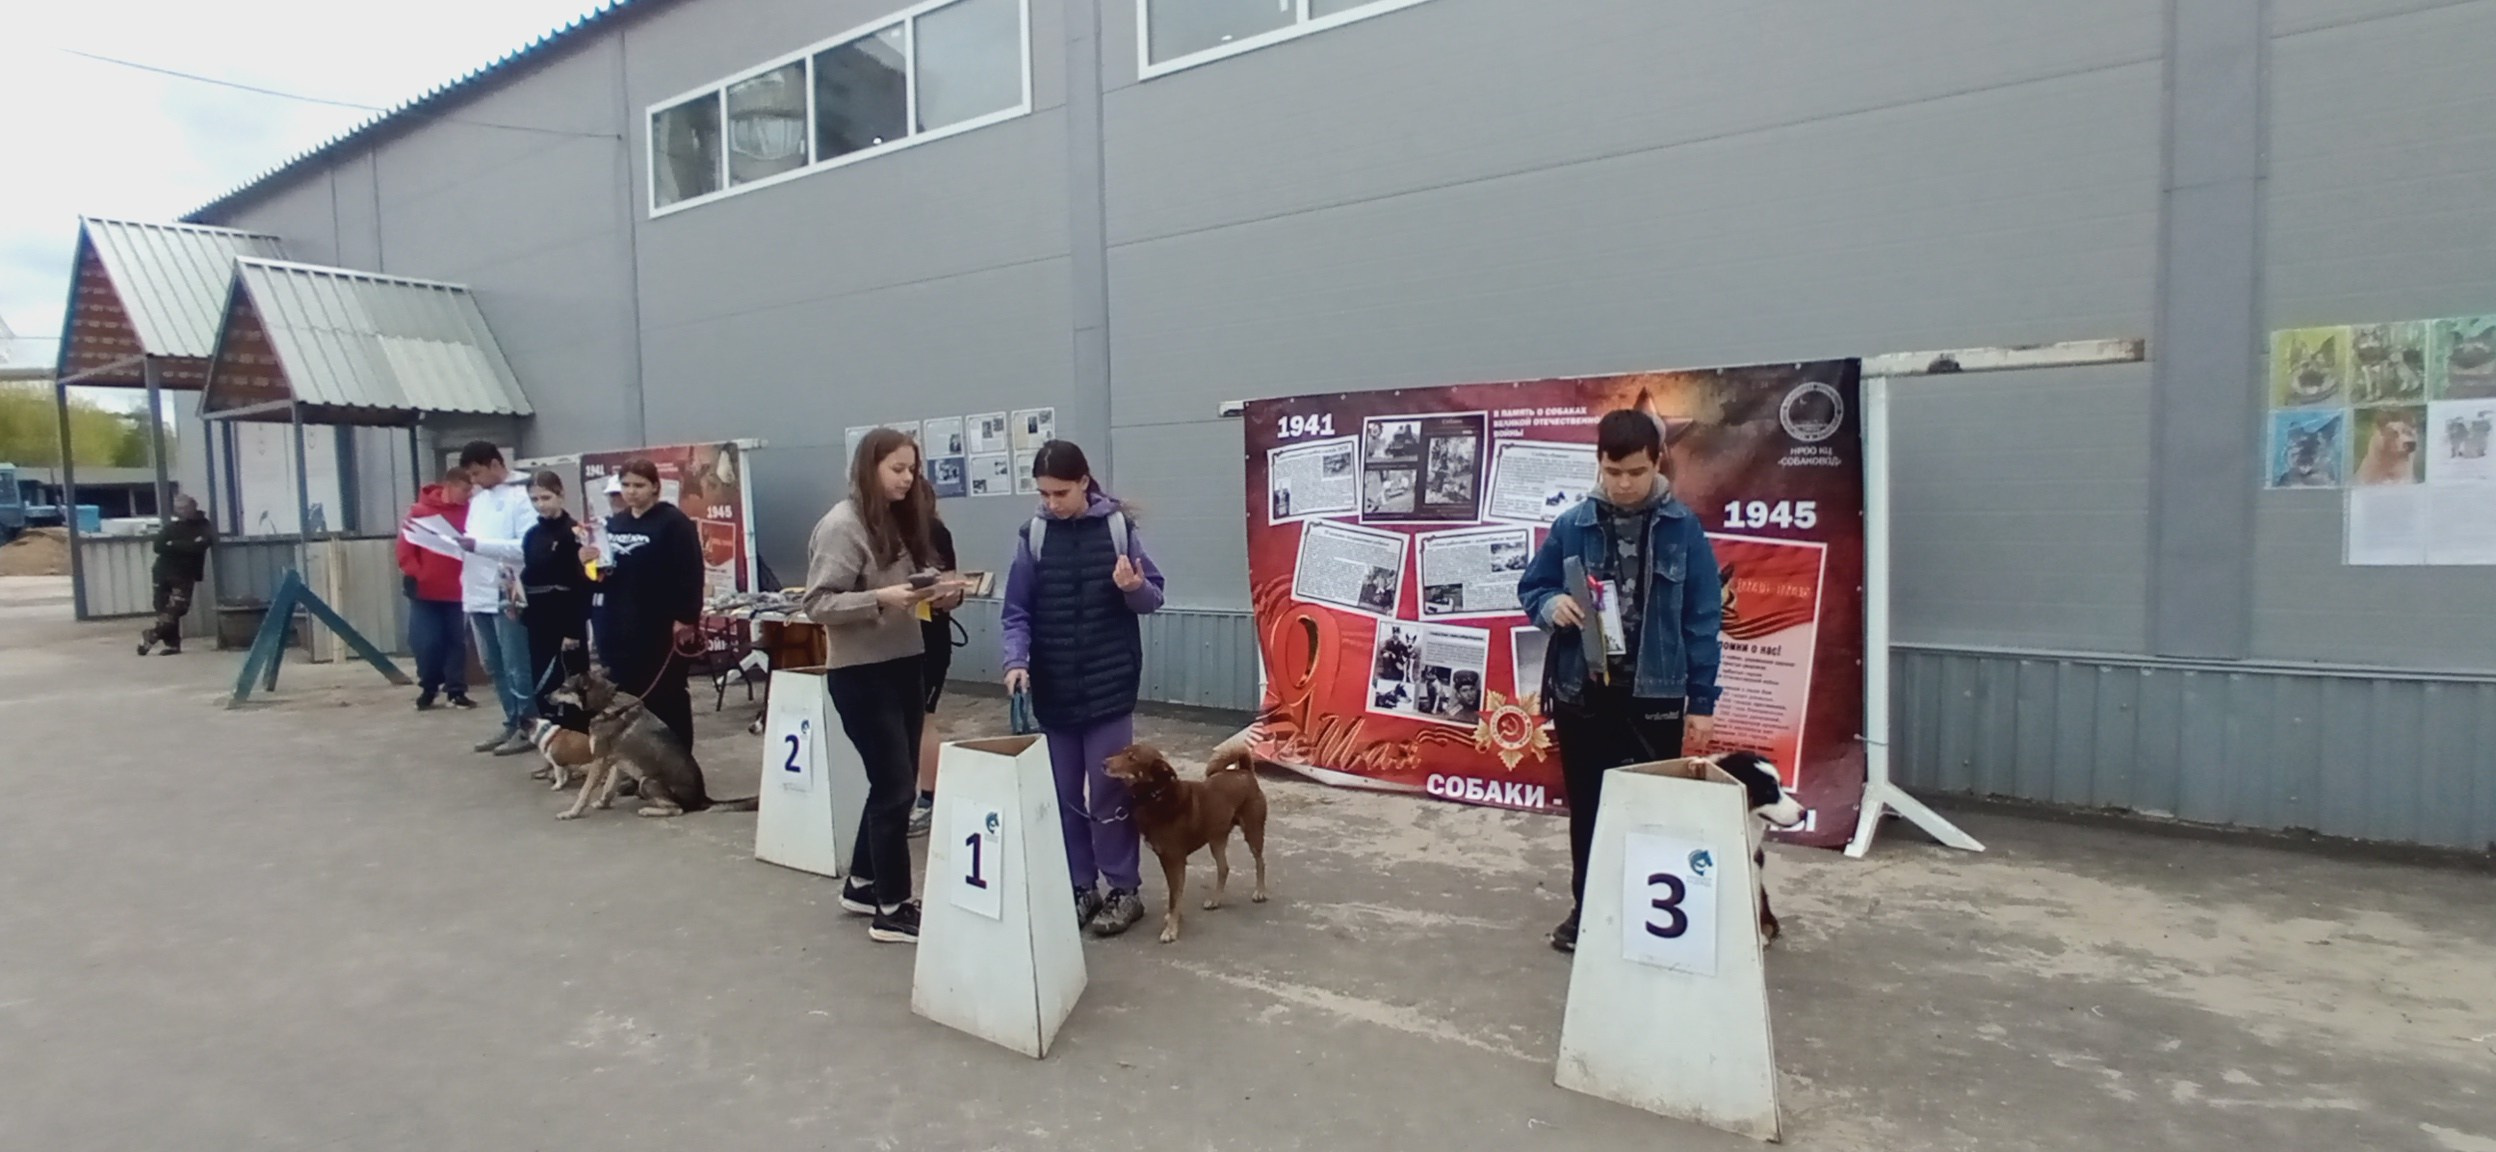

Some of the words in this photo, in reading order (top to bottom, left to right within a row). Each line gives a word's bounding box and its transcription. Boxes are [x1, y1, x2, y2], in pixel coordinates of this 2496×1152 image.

[1277, 412, 1336, 439] 1941
[1493, 418, 1532, 428] ВЕЛИКОЙ
[1533, 416, 1602, 427] ОТЕЧЕСТВЕННО
[1501, 408, 1535, 418] ПАМЯТЬ
[1536, 408, 1543, 416] О
[1545, 406, 1588, 416] СОБАКАХ
[1493, 429, 1524, 438] ВОЙНЫ
[585, 463, 605, 477] 1941
[706, 504, 733, 519] 1945
[1723, 499, 1818, 530] 1945
[783, 733, 802, 774] 2
[1313, 714, 1423, 771] Мая
[1426, 772, 1546, 810] СОБАКИ
[964, 832, 988, 890] 1
[1644, 873, 1689, 939] 3
